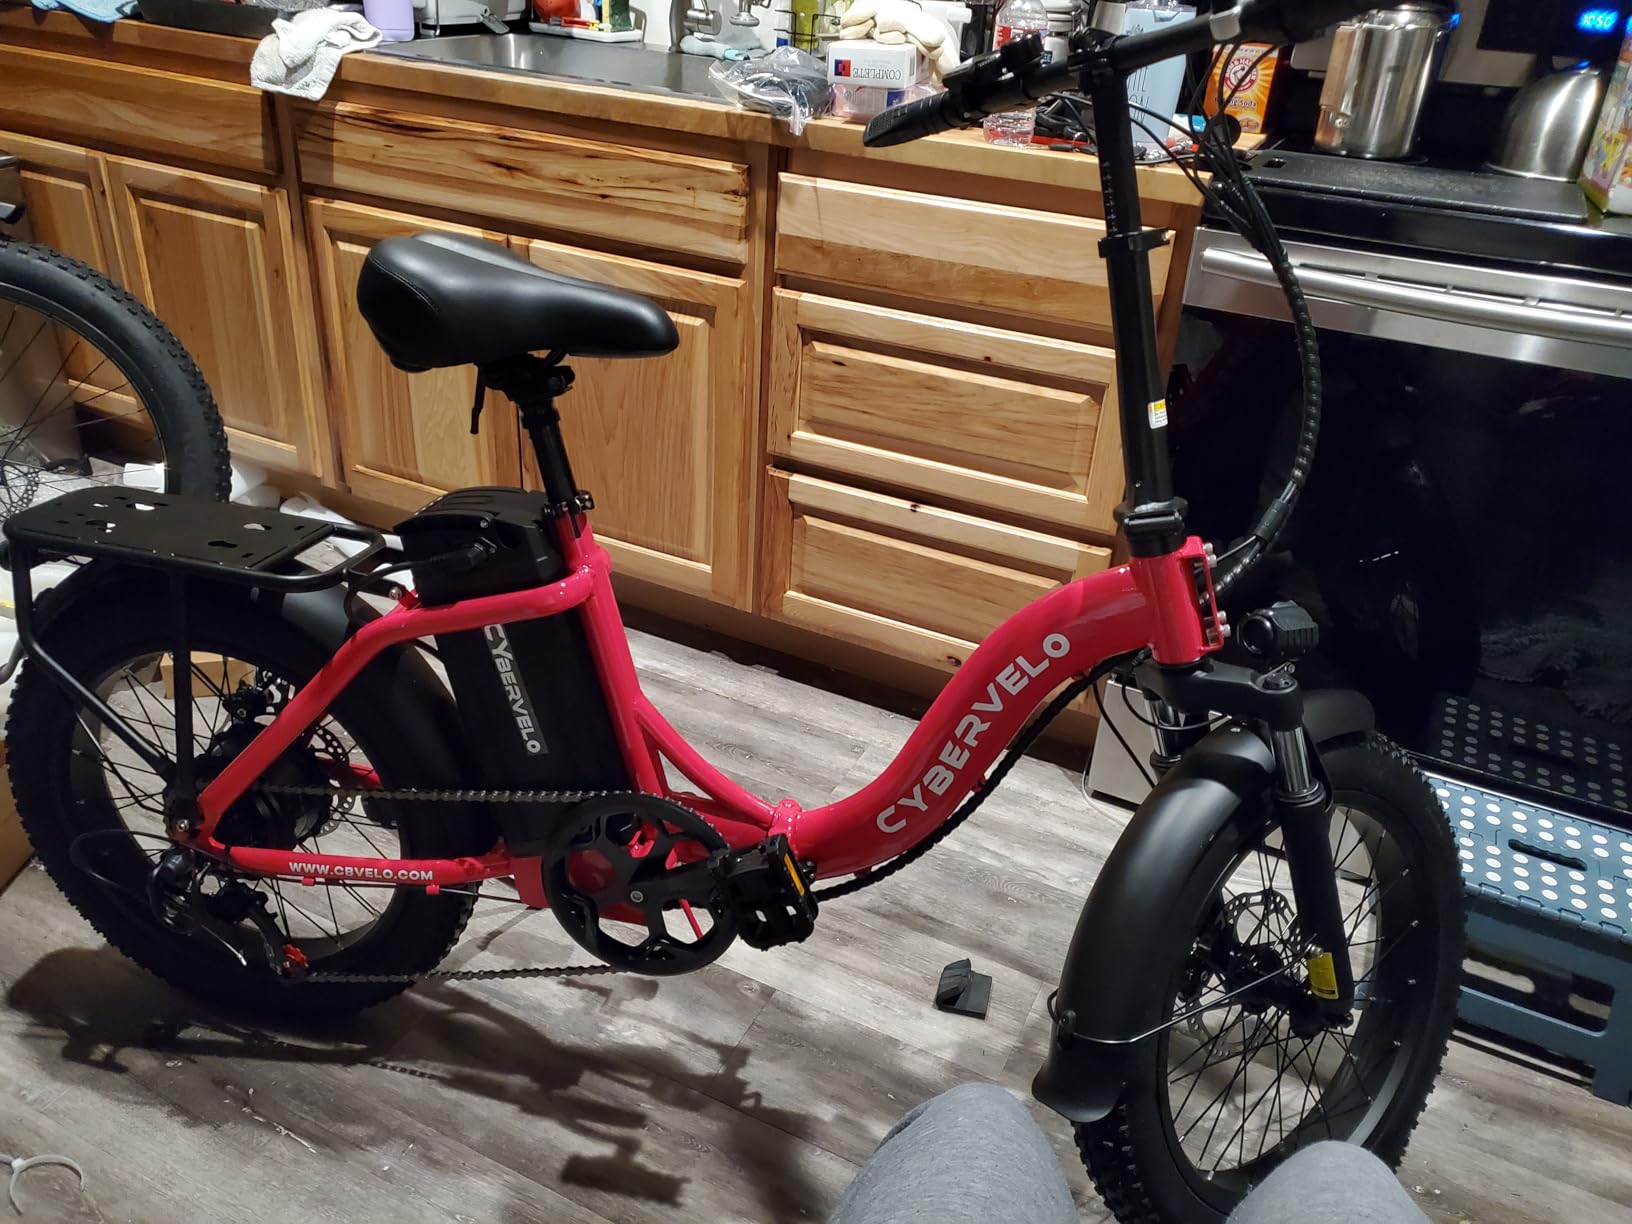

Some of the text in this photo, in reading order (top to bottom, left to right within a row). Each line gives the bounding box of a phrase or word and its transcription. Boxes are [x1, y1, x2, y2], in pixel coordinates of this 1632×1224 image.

[852, 67, 902, 80] COMPLETE
[483, 623, 541, 753] CYBERVELO
[876, 633, 1071, 833] CYBERVELO
[289, 862, 433, 881] WWW.CBVELO.COM
